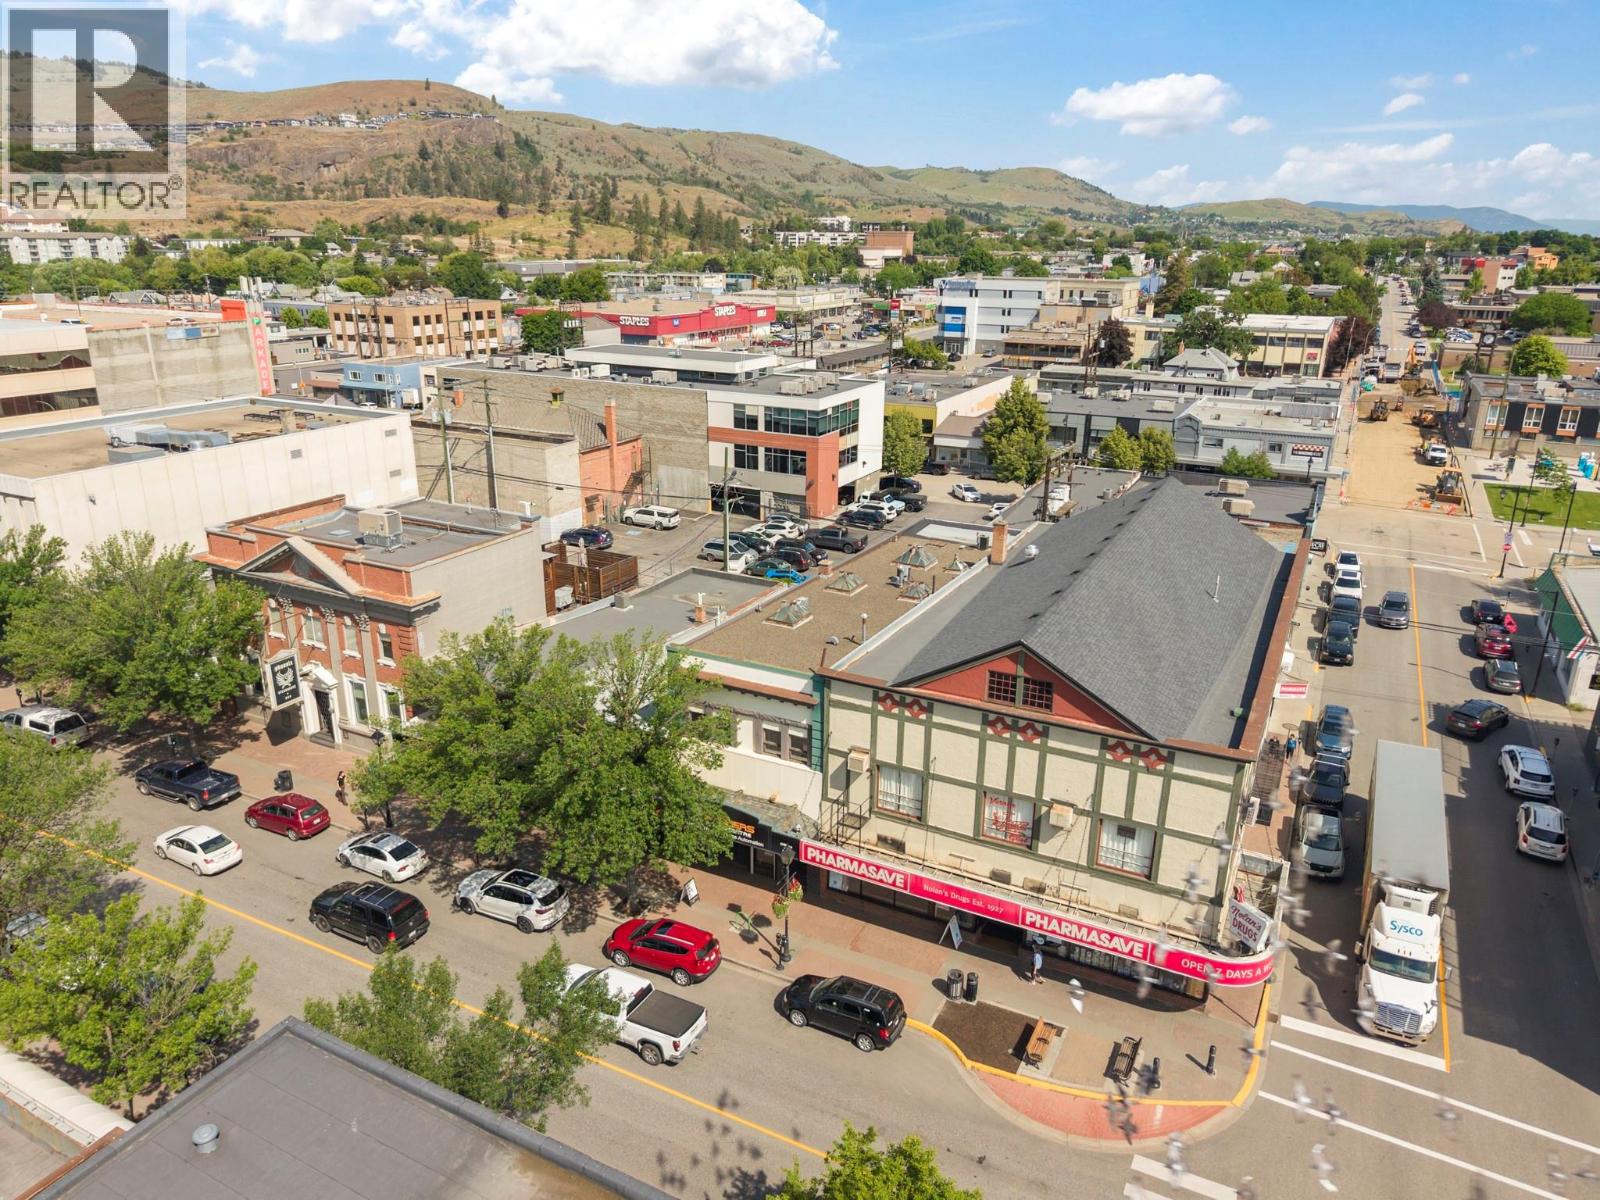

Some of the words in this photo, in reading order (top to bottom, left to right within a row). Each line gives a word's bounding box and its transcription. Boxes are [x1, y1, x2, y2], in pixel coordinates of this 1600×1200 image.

[619, 316, 650, 327] STAPLES
[714, 305, 736, 316] STAPLES
[806, 846, 905, 888] PHARMASAVE
[923, 884, 949, 897] Nolan's
[950, 892, 971, 904] Drugs
[972, 898, 986, 908] Est.
[987, 904, 1004, 914] 1927
[1231, 905, 1262, 931] Nolan's
[1232, 918, 1258, 942] DRUGS
[1390, 920, 1423, 937] Sysco
[1025, 911, 1144, 957] PHARMASAVE
[1226, 969, 1253, 979] DAYS
[1255, 967, 1262, 976] A
